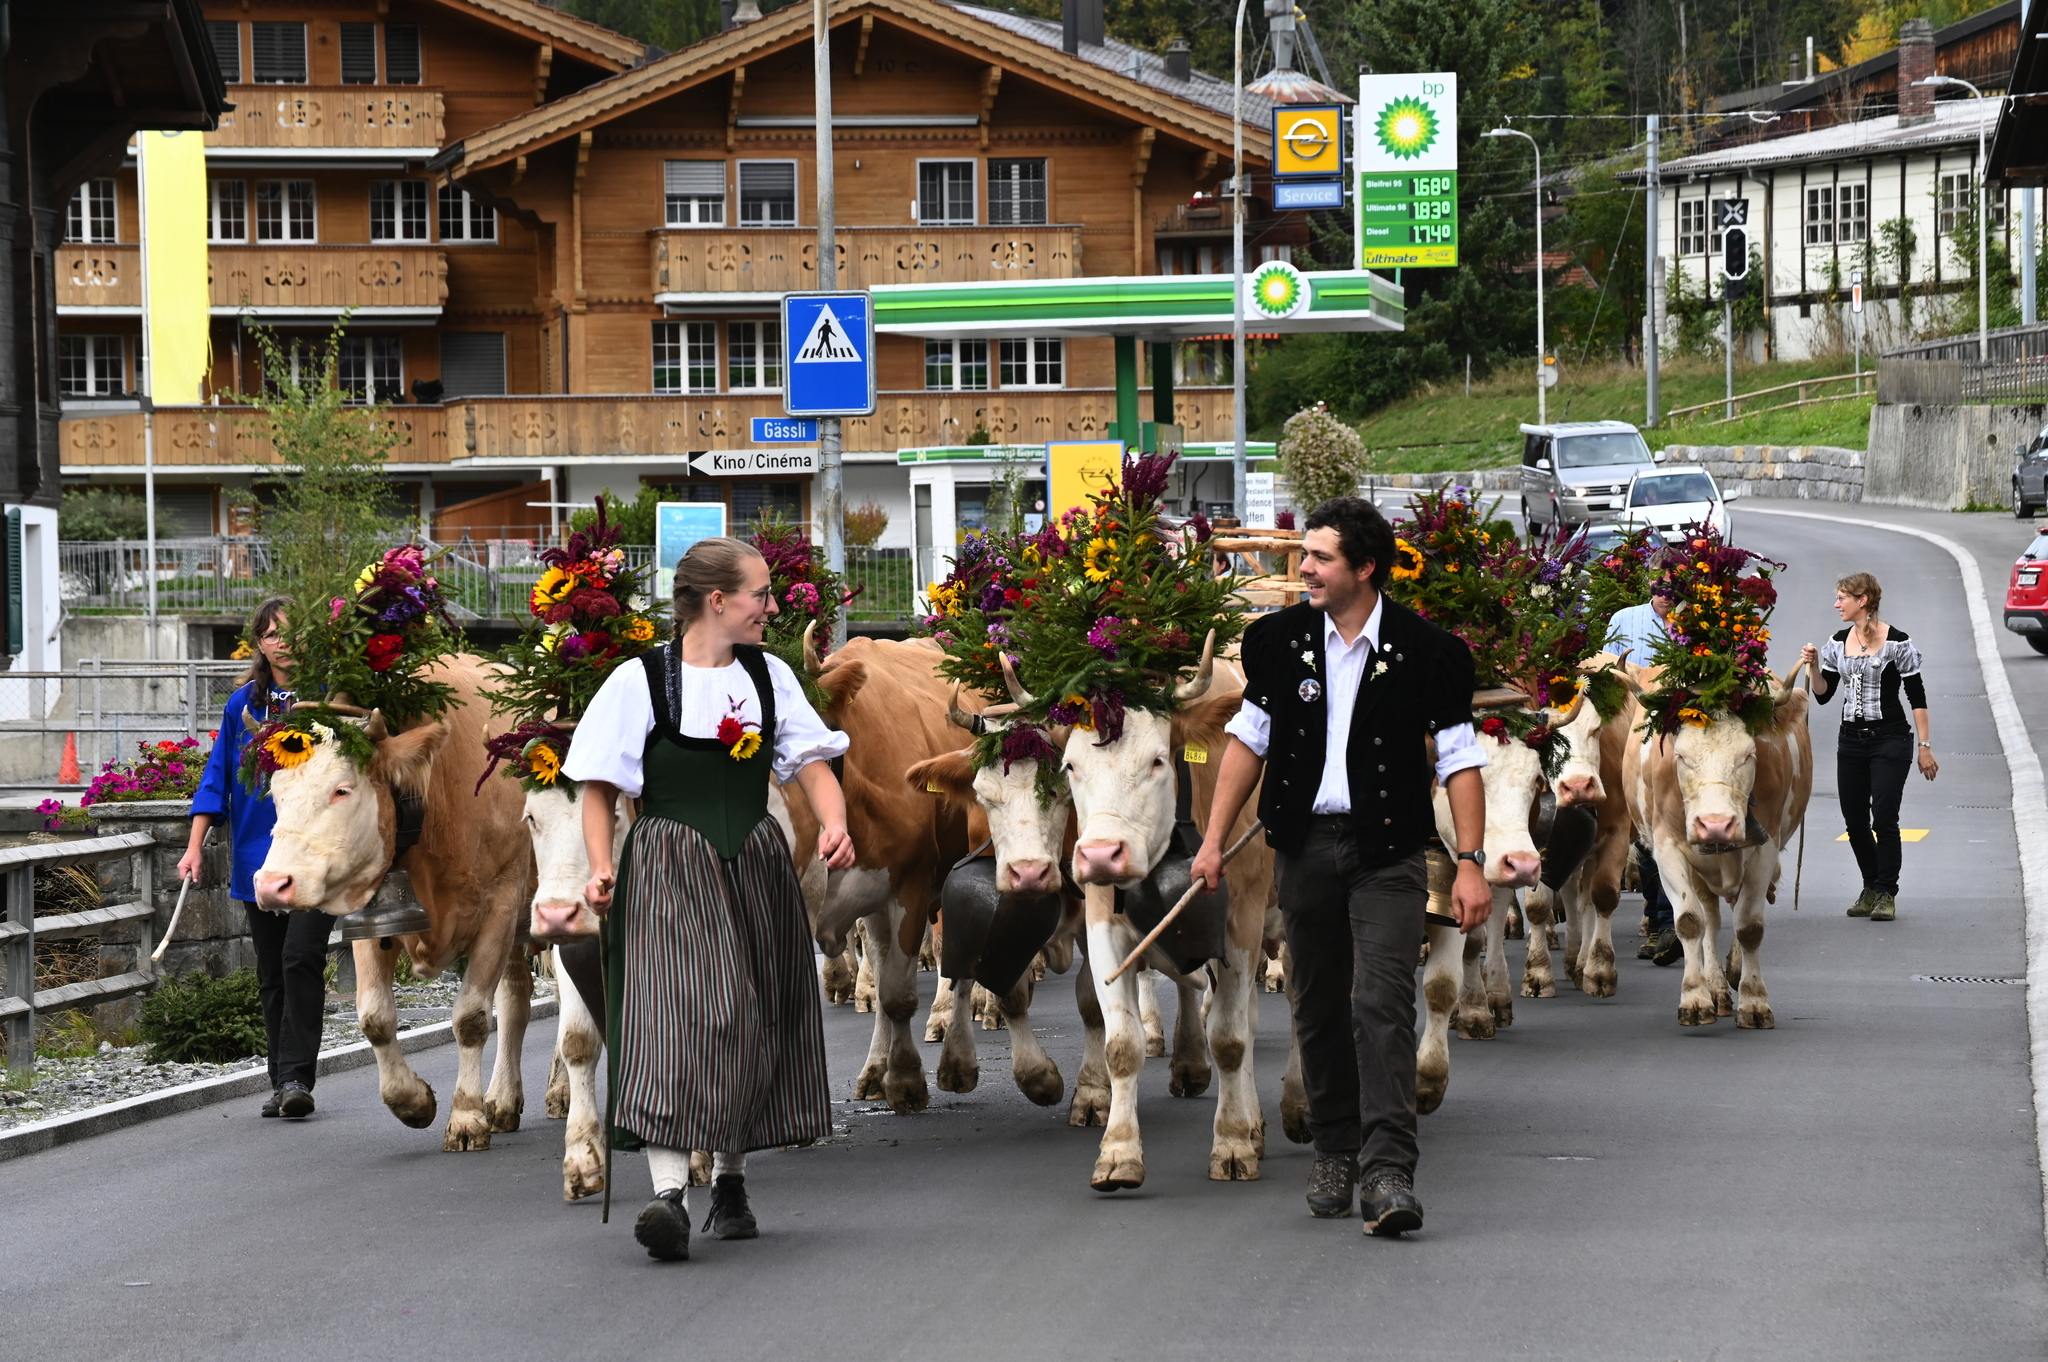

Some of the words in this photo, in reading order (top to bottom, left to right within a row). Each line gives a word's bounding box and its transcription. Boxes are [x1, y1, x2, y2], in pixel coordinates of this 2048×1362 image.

[1422, 80, 1445, 99] bp
[1365, 179, 1392, 188] Bleifrei
[1393, 179, 1403, 188] 95
[1283, 188, 1333, 203] Service
[1365, 203, 1397, 212] Ultimate
[1397, 203, 1407, 211] 98
[1365, 227, 1390, 236] Diesel
[1366, 253, 1419, 264] ultimate
[764, 421, 806, 439] Gässli
[1016, 448, 1047, 459] Garag
[1215, 446, 1235, 456] Die
